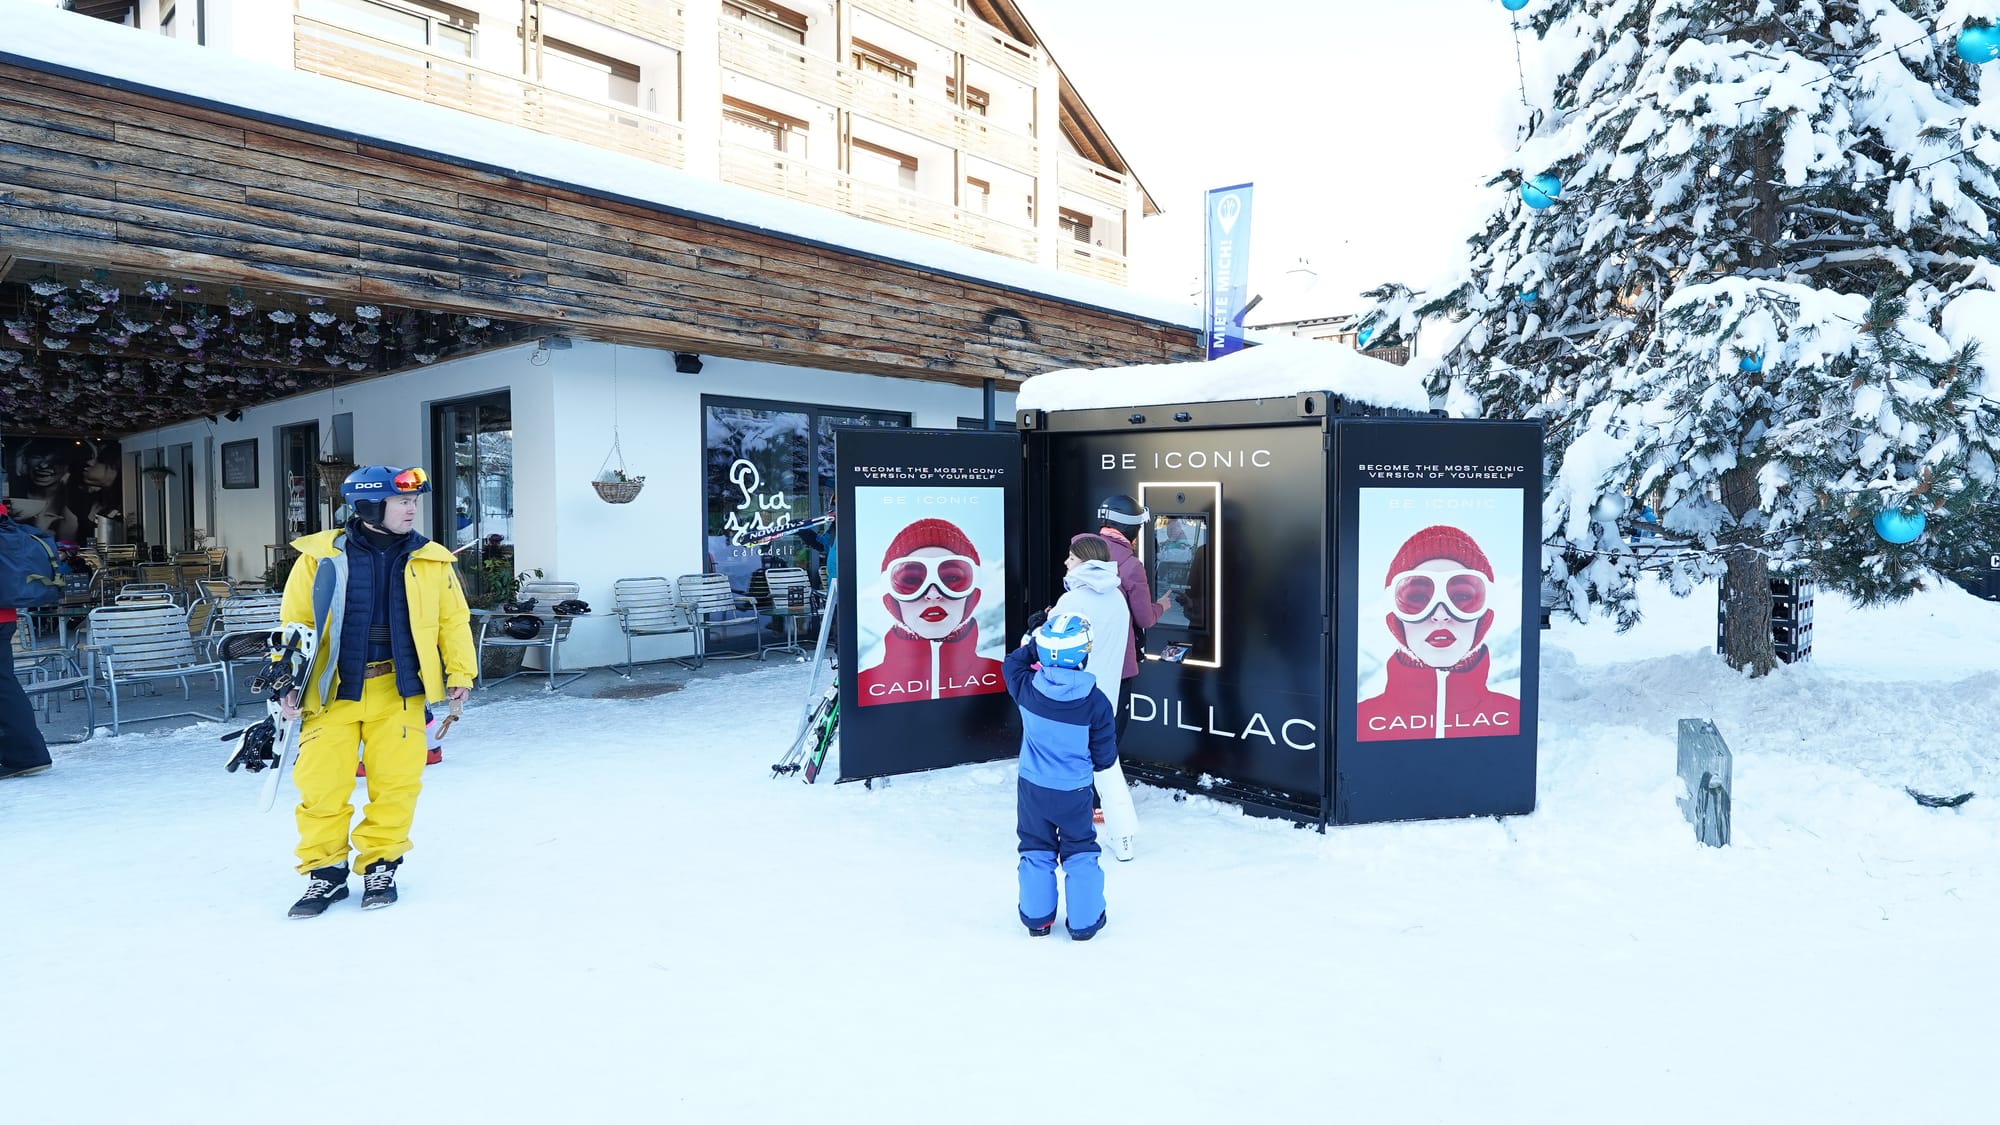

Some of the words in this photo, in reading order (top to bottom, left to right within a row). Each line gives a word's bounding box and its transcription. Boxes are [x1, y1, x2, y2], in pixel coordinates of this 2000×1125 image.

[1217, 240, 1232, 293] MICH!
[1213, 297, 1228, 348] MIETE
[1101, 453, 1137, 470] BE
[1154, 450, 1271, 469] ICONIC
[729, 459, 791, 510] Pia
[882, 496, 906, 504] BE
[917, 496, 980, 504] ICONIC
[1389, 498, 1416, 509] BE
[1425, 498, 1496, 509] ICONIC
[749, 519, 805, 539] SALOMON
[1125, 692, 1317, 751] DILLAC
